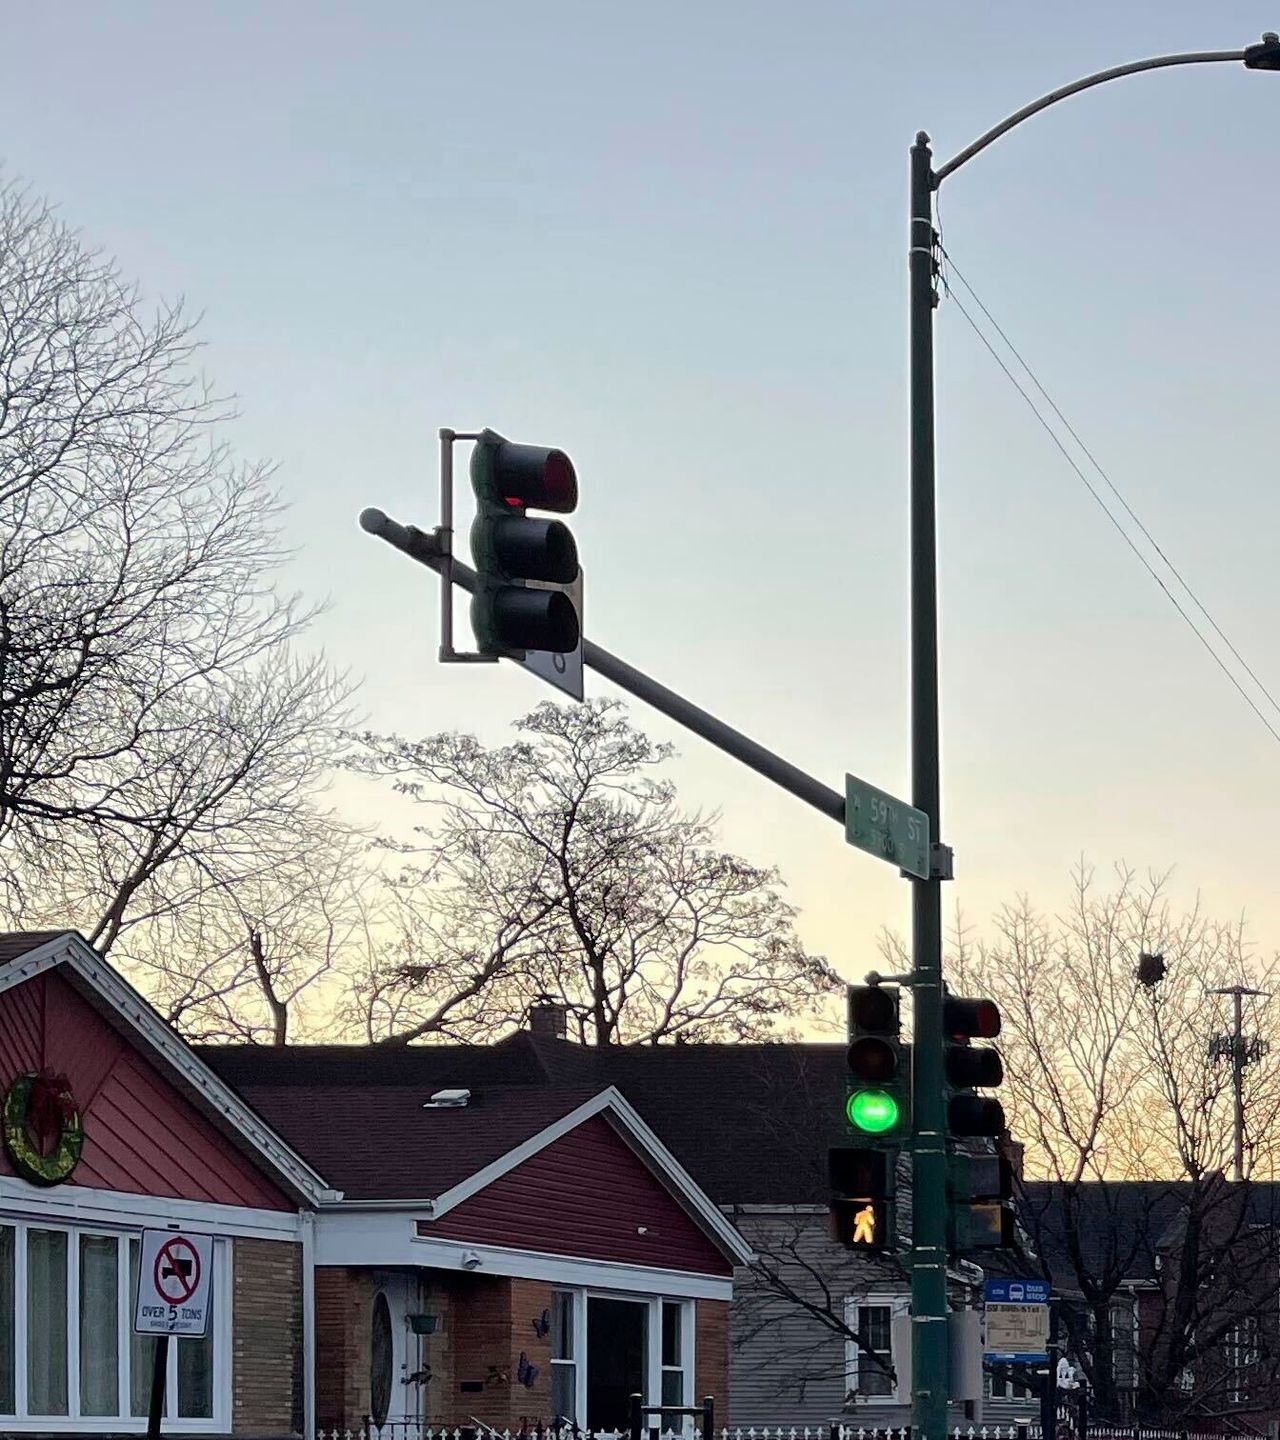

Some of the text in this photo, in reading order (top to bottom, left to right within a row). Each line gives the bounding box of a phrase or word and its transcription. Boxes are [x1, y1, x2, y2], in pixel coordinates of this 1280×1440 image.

[908, 816, 921, 842] ST
[142, 1304, 202, 1321] OVER 5 TONS
